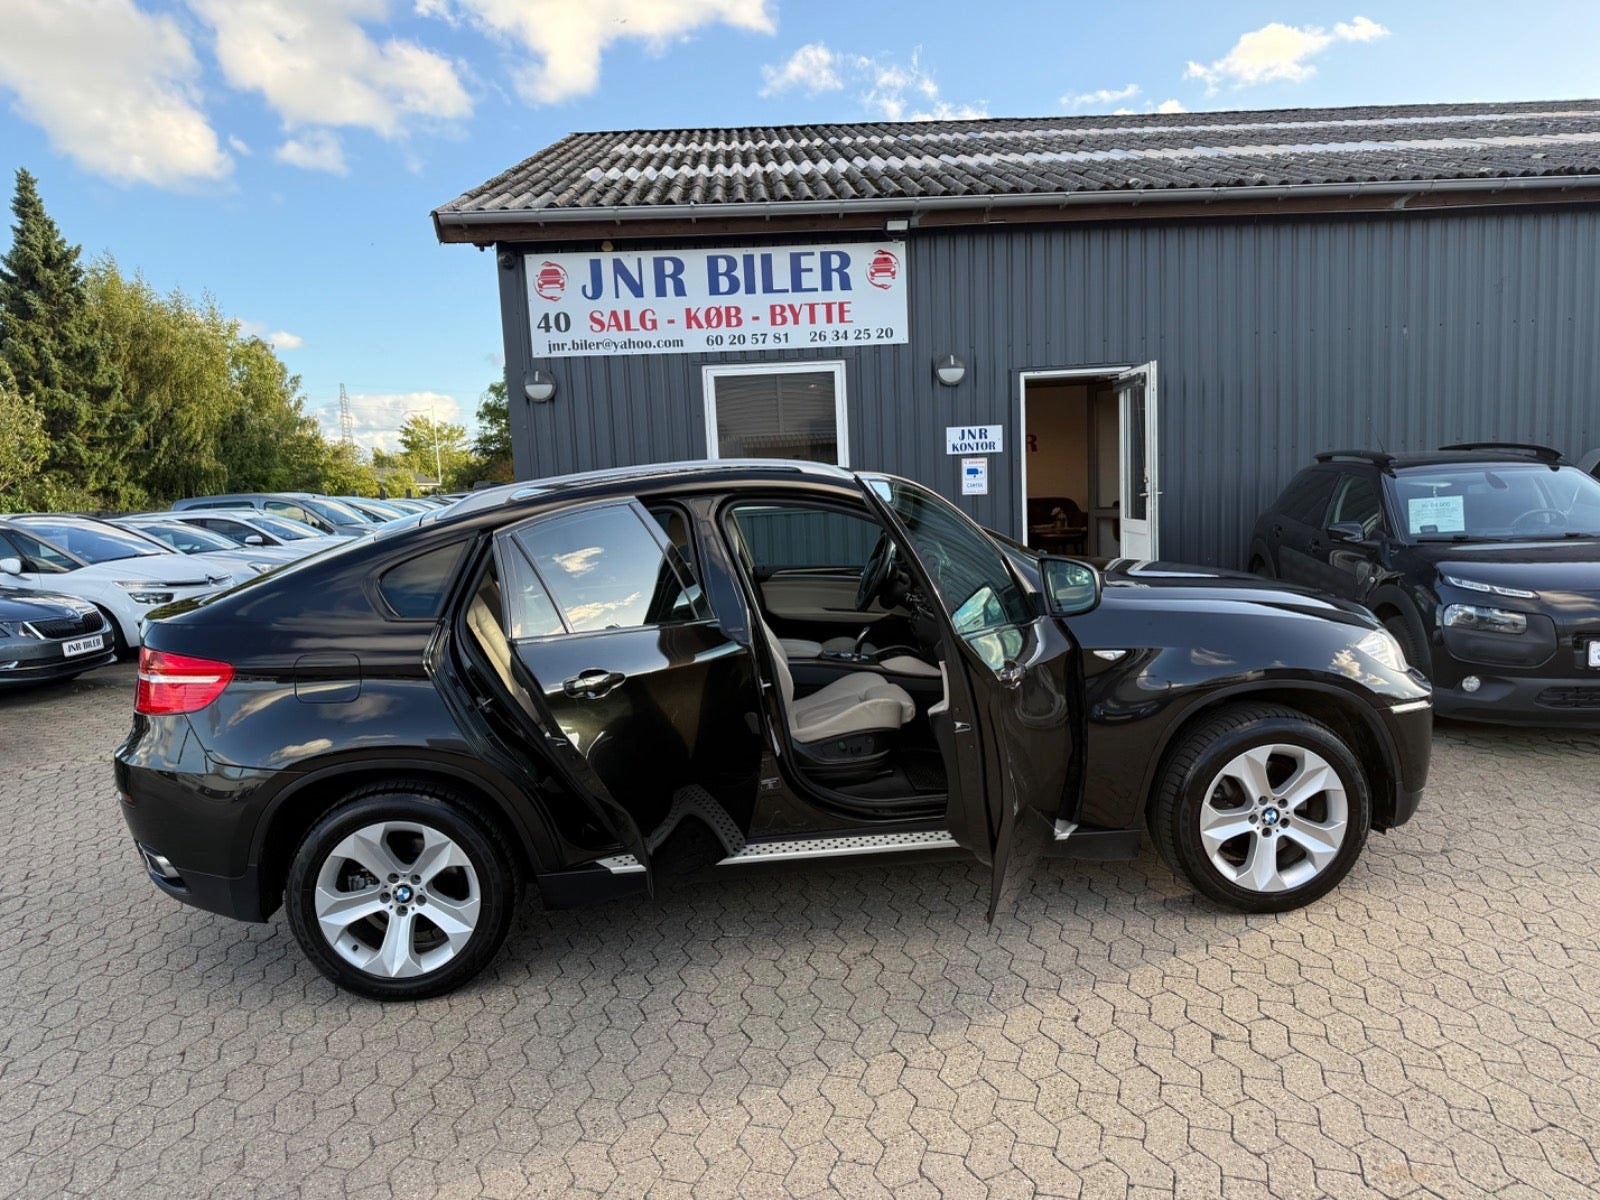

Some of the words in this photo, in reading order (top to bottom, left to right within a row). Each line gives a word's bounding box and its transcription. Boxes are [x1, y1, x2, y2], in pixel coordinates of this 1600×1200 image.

[581, 256, 687, 300] JNR
[706, 250, 852, 296] BILER
[537, 311, 571, 333] 40
[589, 308, 658, 333] SALG
[684, 305, 743, 330] KØB
[769, 301, 854, 327] BYTTE
[548, 337, 684, 354] jnr.biler@yahoo.com
[706, 334, 724, 346] 60
[728, 333, 746, 345] 20
[751, 333, 768, 344] 57
[773, 332, 789, 344] 81
[809, 330, 827, 342] 26
[831, 329, 849, 341] 34
[854, 328, 871, 340] 25
[876, 327, 894, 339] 20
[959, 428, 988, 440] JNR
[952, 441, 995, 452] KONTOR
